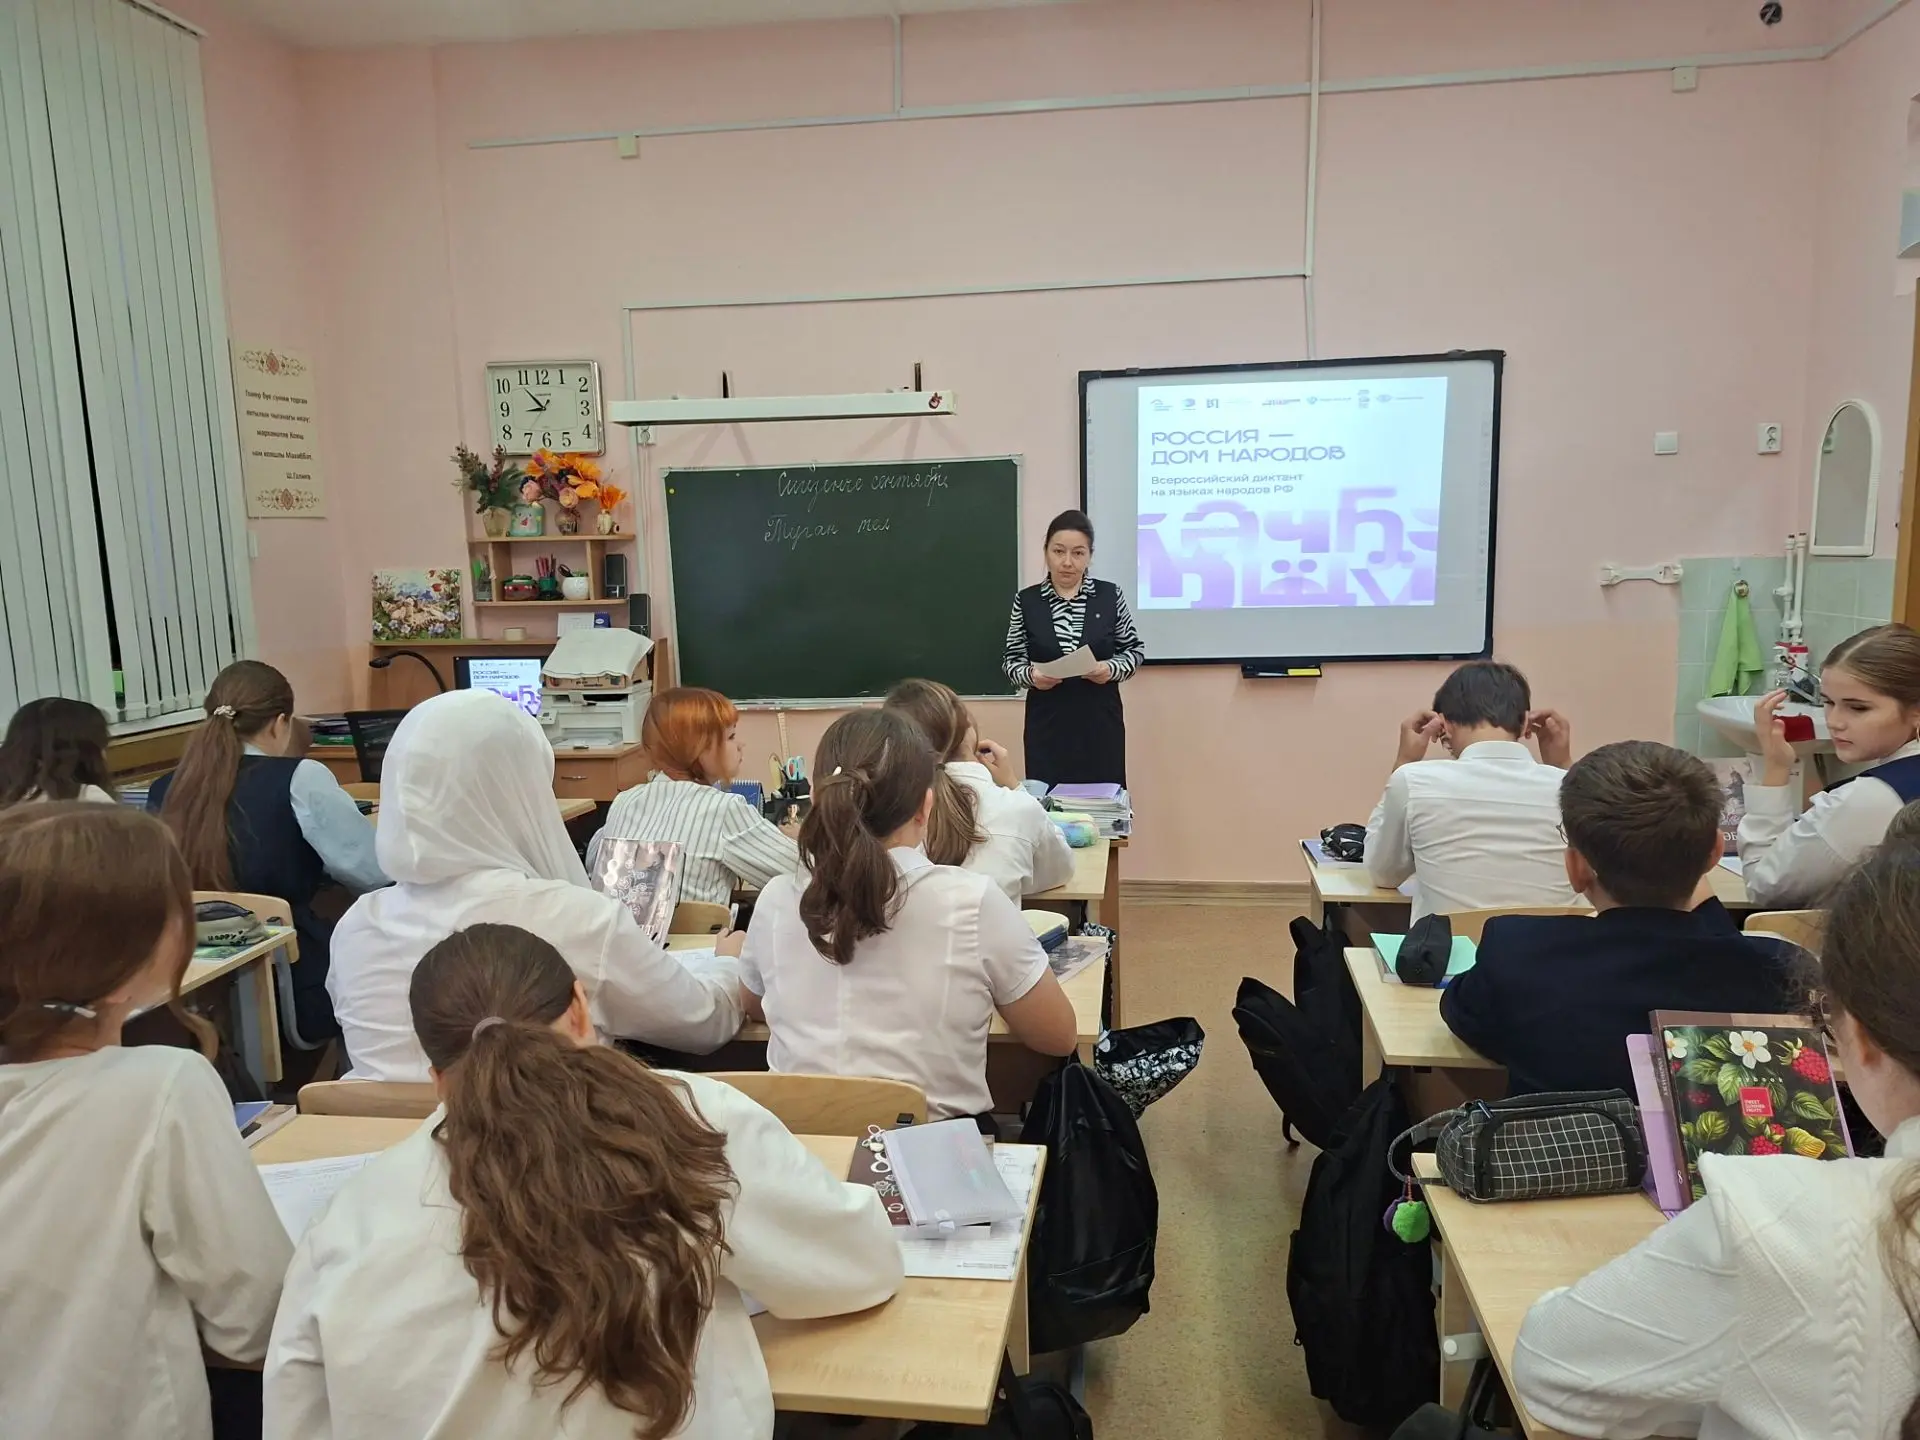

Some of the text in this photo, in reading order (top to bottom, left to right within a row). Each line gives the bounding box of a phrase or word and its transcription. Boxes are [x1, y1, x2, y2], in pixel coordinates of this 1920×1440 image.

[518, 370, 529, 386] 11
[535, 369, 550, 385] 12
[558, 369, 565, 385] 1
[578, 377, 589, 393] 2
[496, 378, 511, 394] 10
[500, 402, 510, 418] 9
[580, 400, 591, 416] 3
[502, 424, 512, 440] 8
[561, 432, 571, 447] 5
[582, 424, 592, 439] 4
[1151, 429, 1259, 446] РОССИЯ
[524, 432, 533, 448] 7
[542, 432, 552, 448] 6
[1151, 445, 1346, 465] ДОМ НАРОДОВ
[1151, 473, 1304, 486] Всероссийский диктант
[1151, 484, 1294, 497] на языках народов РФ
